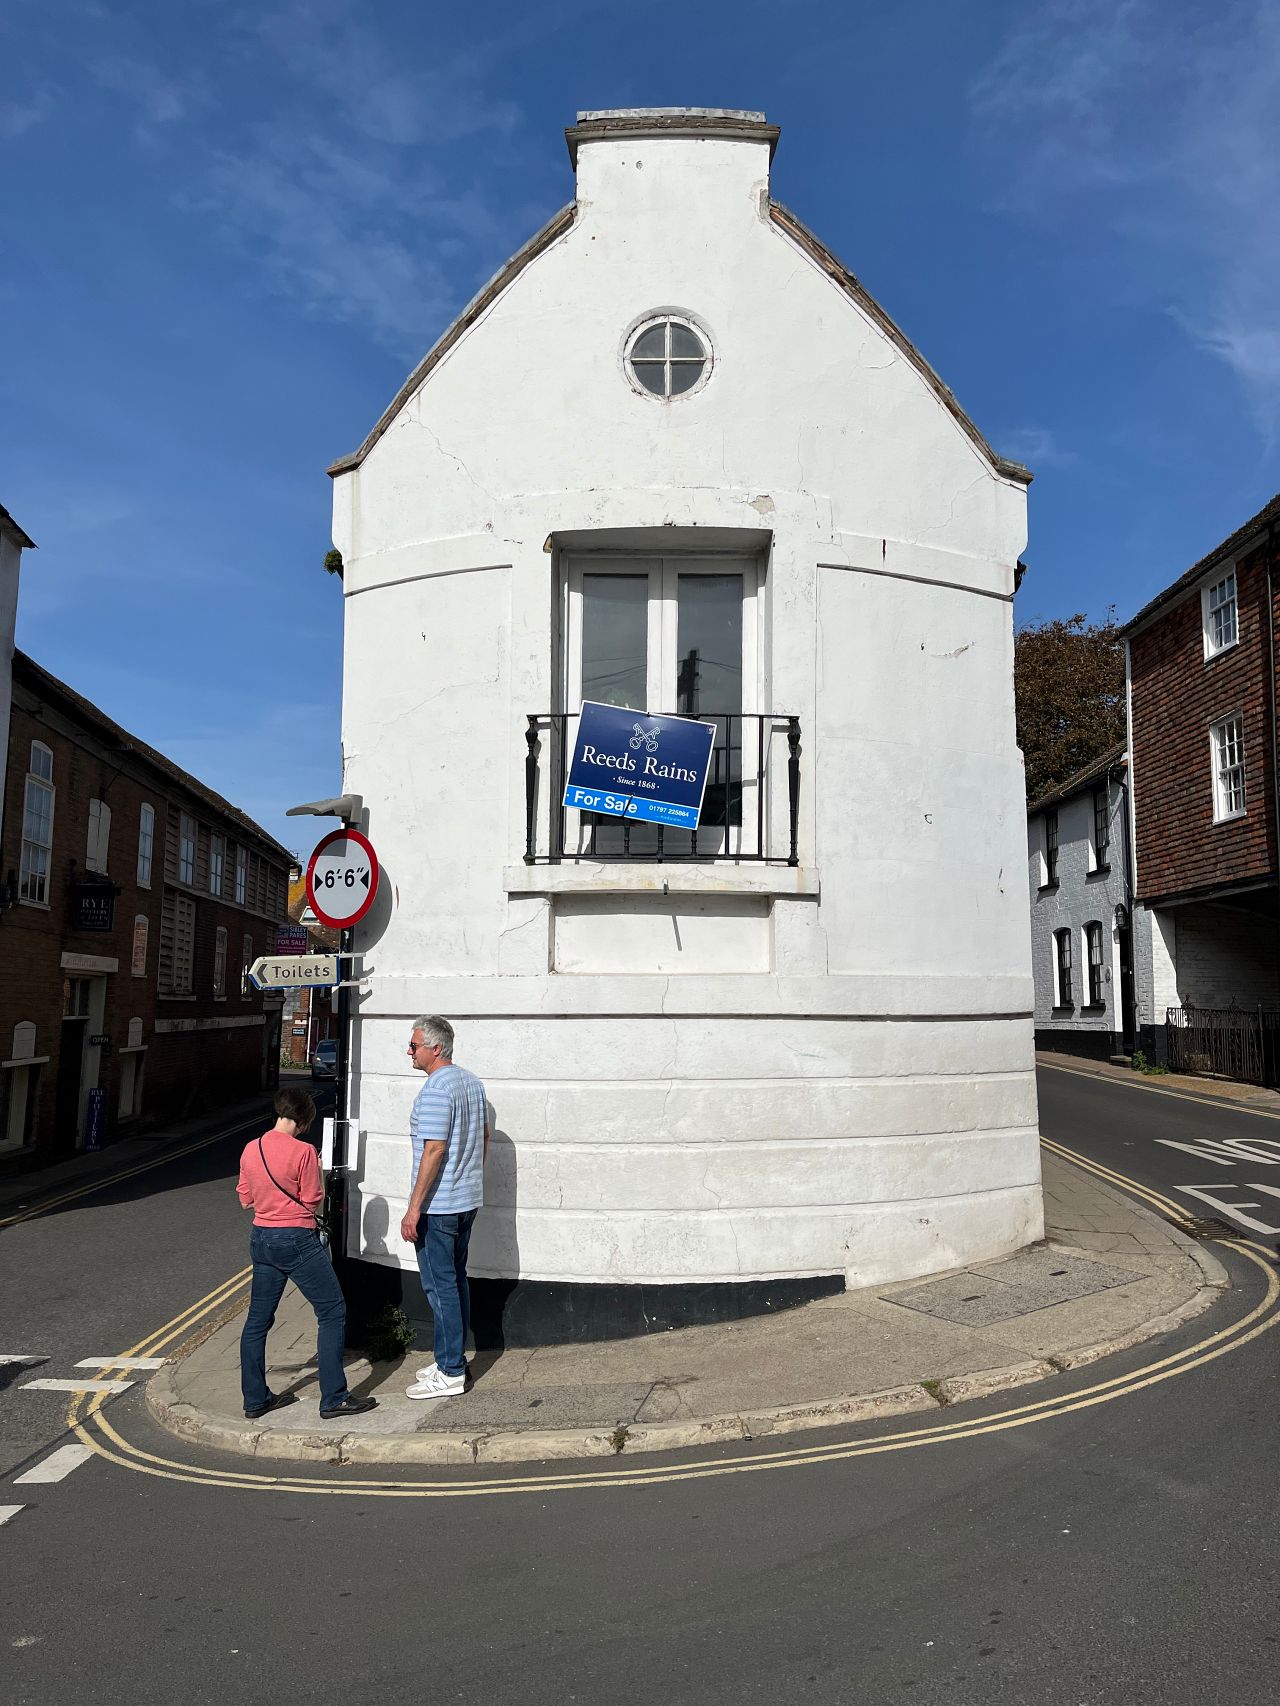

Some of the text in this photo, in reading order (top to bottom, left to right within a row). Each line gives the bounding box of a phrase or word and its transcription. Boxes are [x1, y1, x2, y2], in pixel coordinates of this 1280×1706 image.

[581, 745, 697, 783] Reeds Rains
[616, 775, 656, 790] Since 1868
[574, 790, 638, 814] For Sale
[649, 804, 667, 814] 01797
[82, 898, 109, 908] RYE
[271, 964, 330, 979] Toilets
